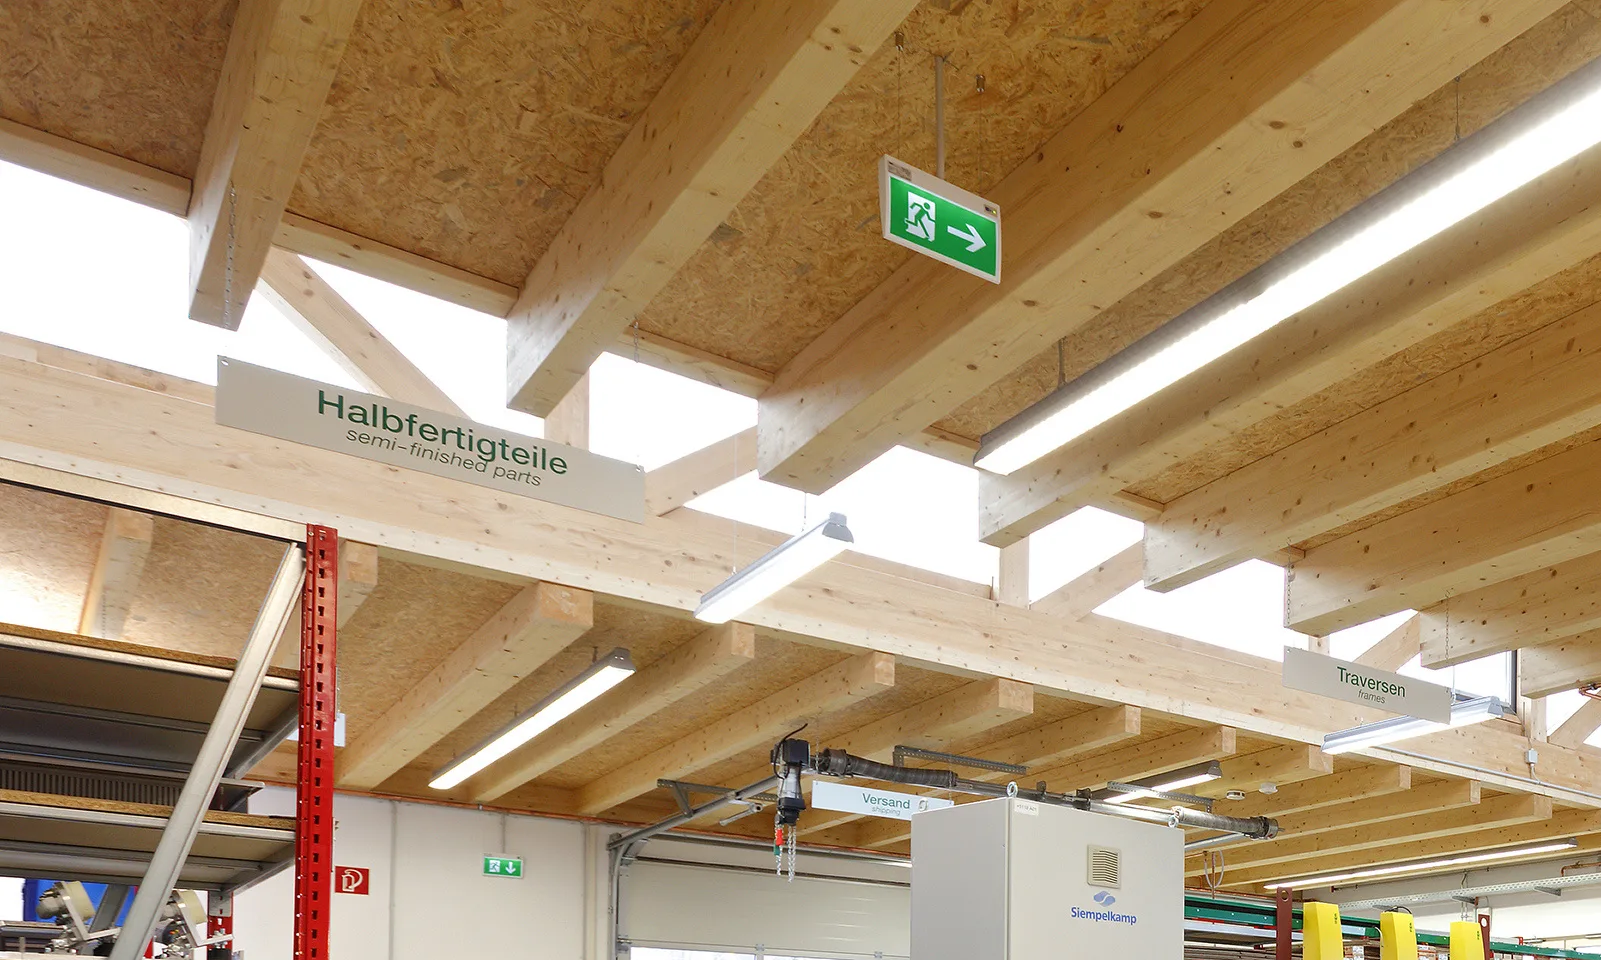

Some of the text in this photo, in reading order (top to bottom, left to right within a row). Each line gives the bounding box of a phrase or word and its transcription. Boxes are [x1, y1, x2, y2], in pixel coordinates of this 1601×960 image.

[318, 390, 569, 475] Halbfertigteile
[346, 429, 542, 487] semi-finished parts
[1337, 666, 1406, 698] Traversen
[1358, 690, 1386, 704] frames
[862, 793, 910, 809] Versand
[872, 806, 901, 816] shipping
[1071, 907, 1137, 925] Siempelkamp
